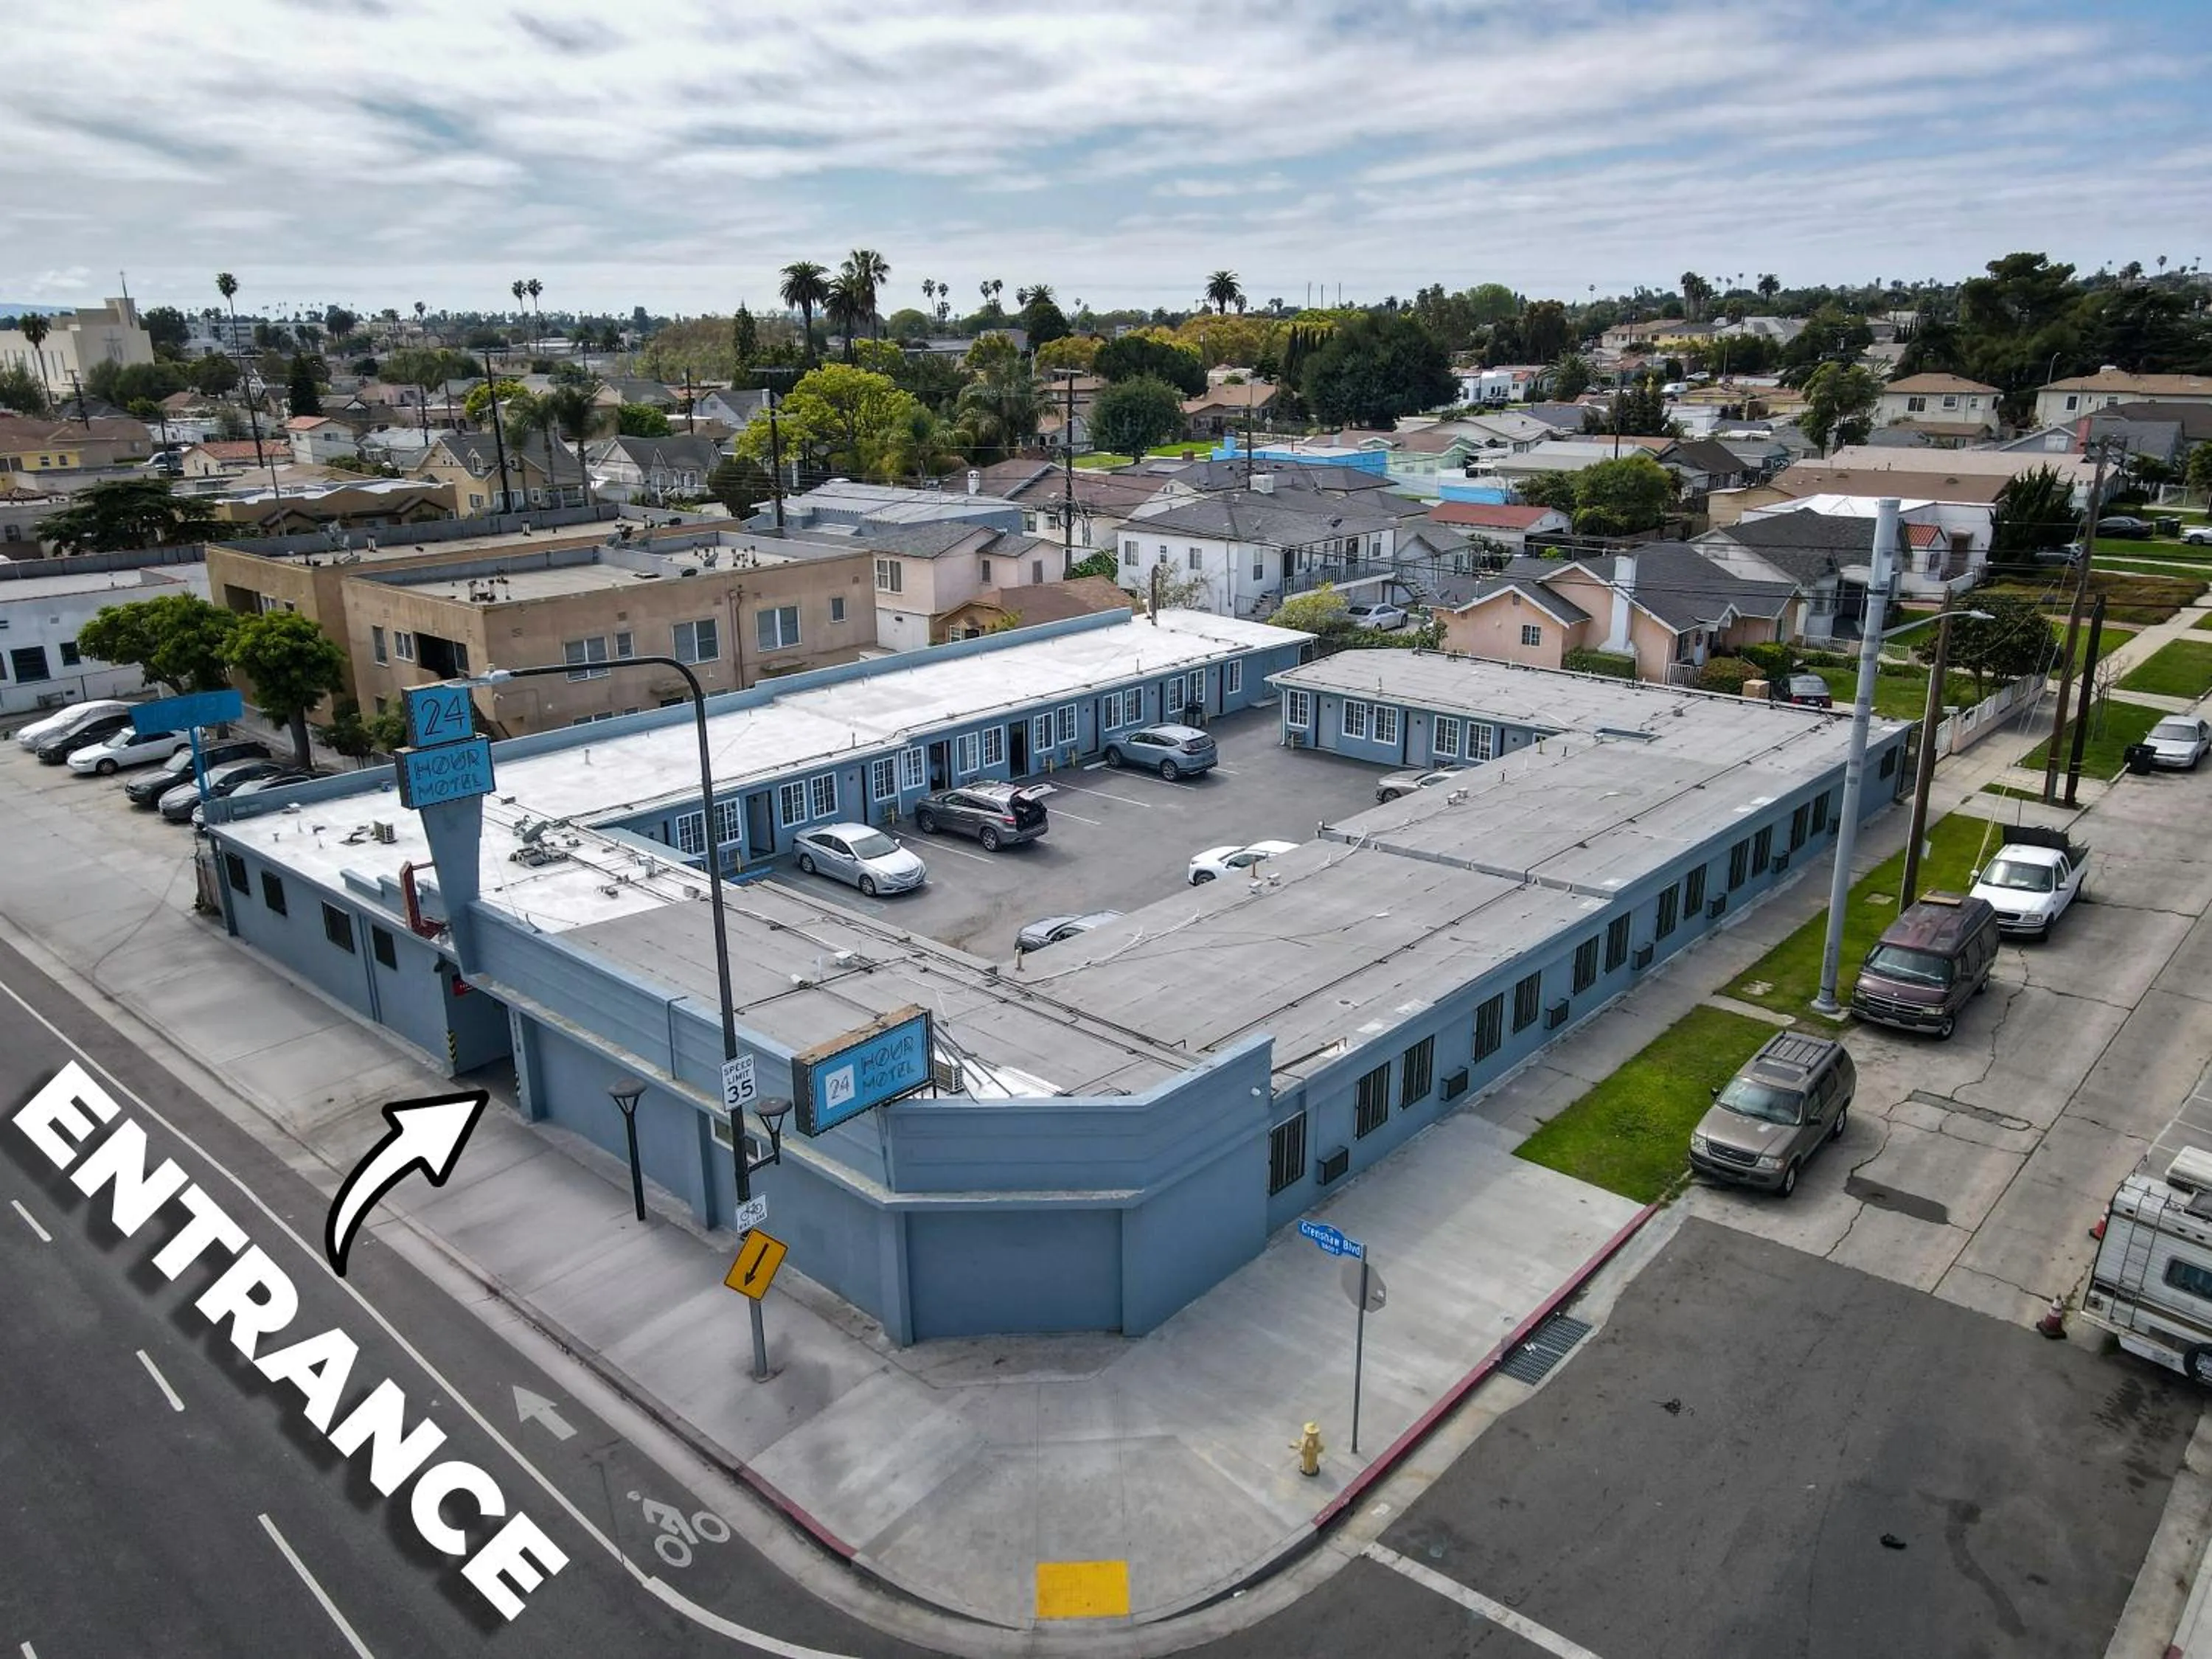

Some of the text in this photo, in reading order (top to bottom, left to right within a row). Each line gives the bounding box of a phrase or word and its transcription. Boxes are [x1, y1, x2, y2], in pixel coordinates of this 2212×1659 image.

[421, 695, 465, 736] 24
[414, 748, 480, 779] HOUR
[417, 774, 481, 799] MOTEL
[723, 1058, 752, 1076] SPEED
[860, 1036, 914, 1075] HOUR
[727, 1068, 750, 1085] LIMIT
[830, 1075, 850, 1100] 24
[862, 1060, 915, 1091] MOTEL
[728, 1079, 754, 1104] 35
[1301, 1222, 1340, 1246] Crenshaw
[1343, 1239, 1360, 1256] Blvd
